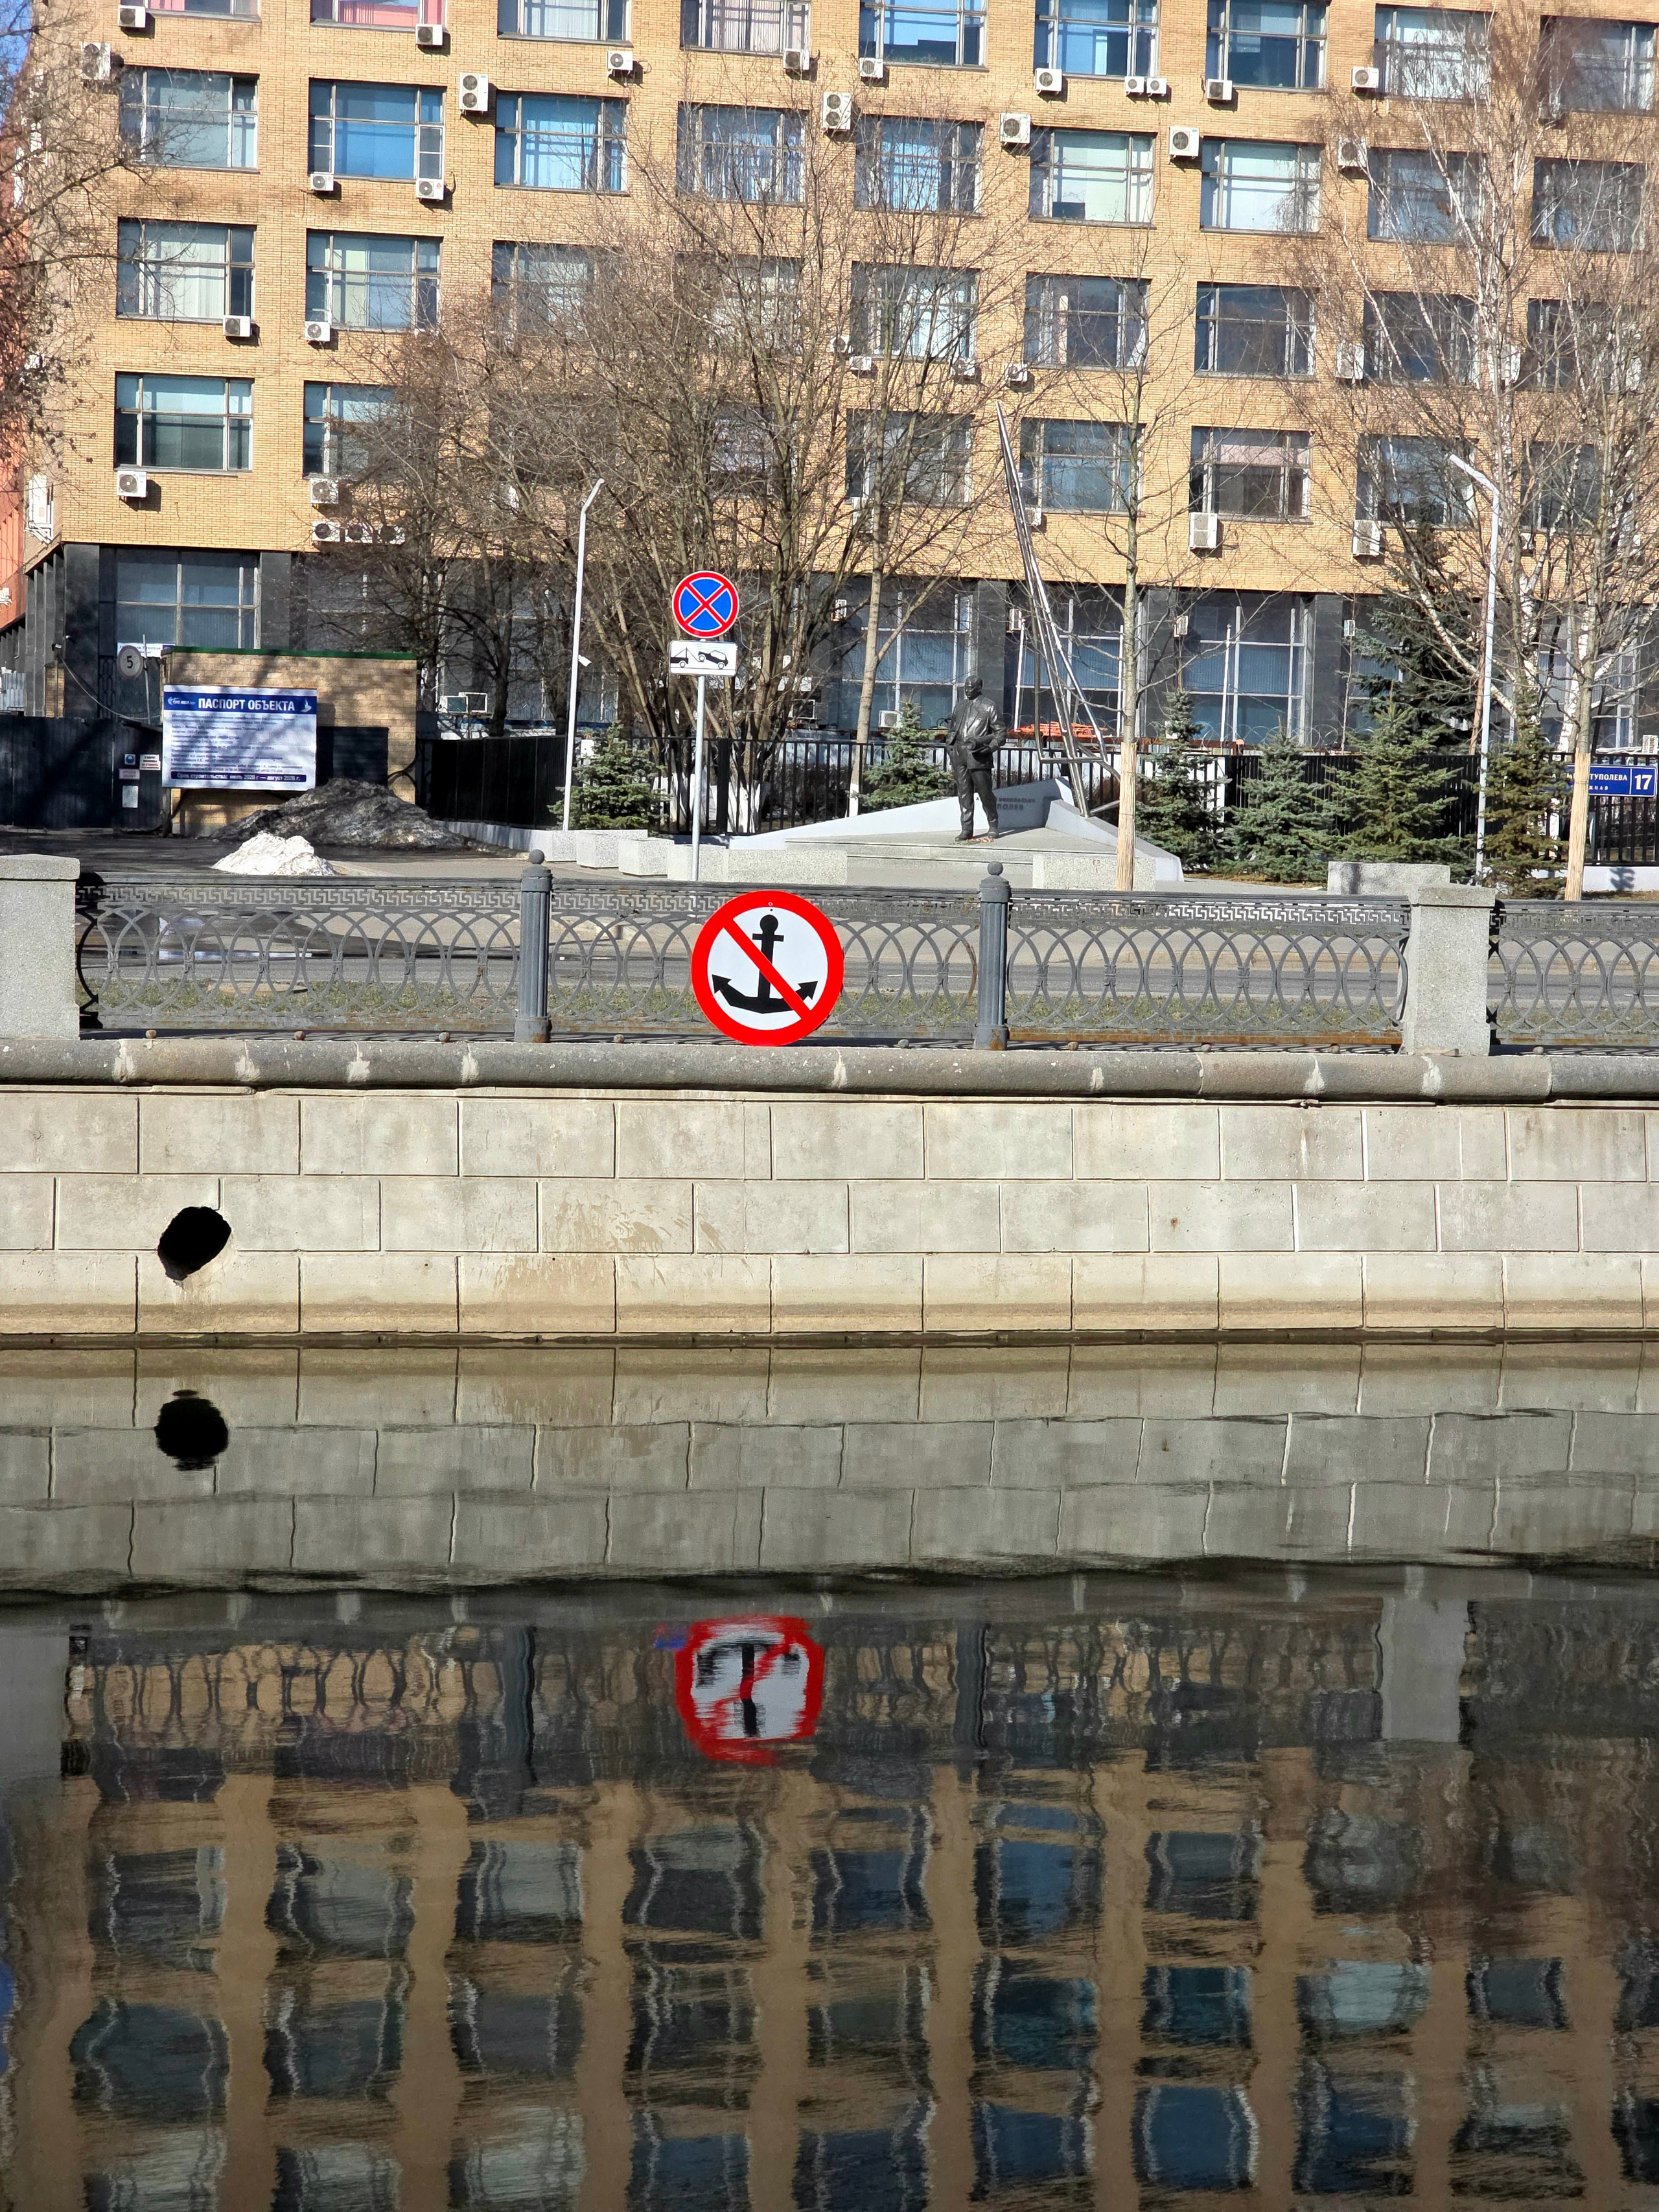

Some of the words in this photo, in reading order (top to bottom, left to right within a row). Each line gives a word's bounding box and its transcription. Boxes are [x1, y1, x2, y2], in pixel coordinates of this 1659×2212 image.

[126, 655, 133, 669] 5
[198, 698, 246, 710] ПАСПОРТ
[248, 699, 296, 711] ОБЪЕКТА
[1634, 774, 1653, 790] 17
